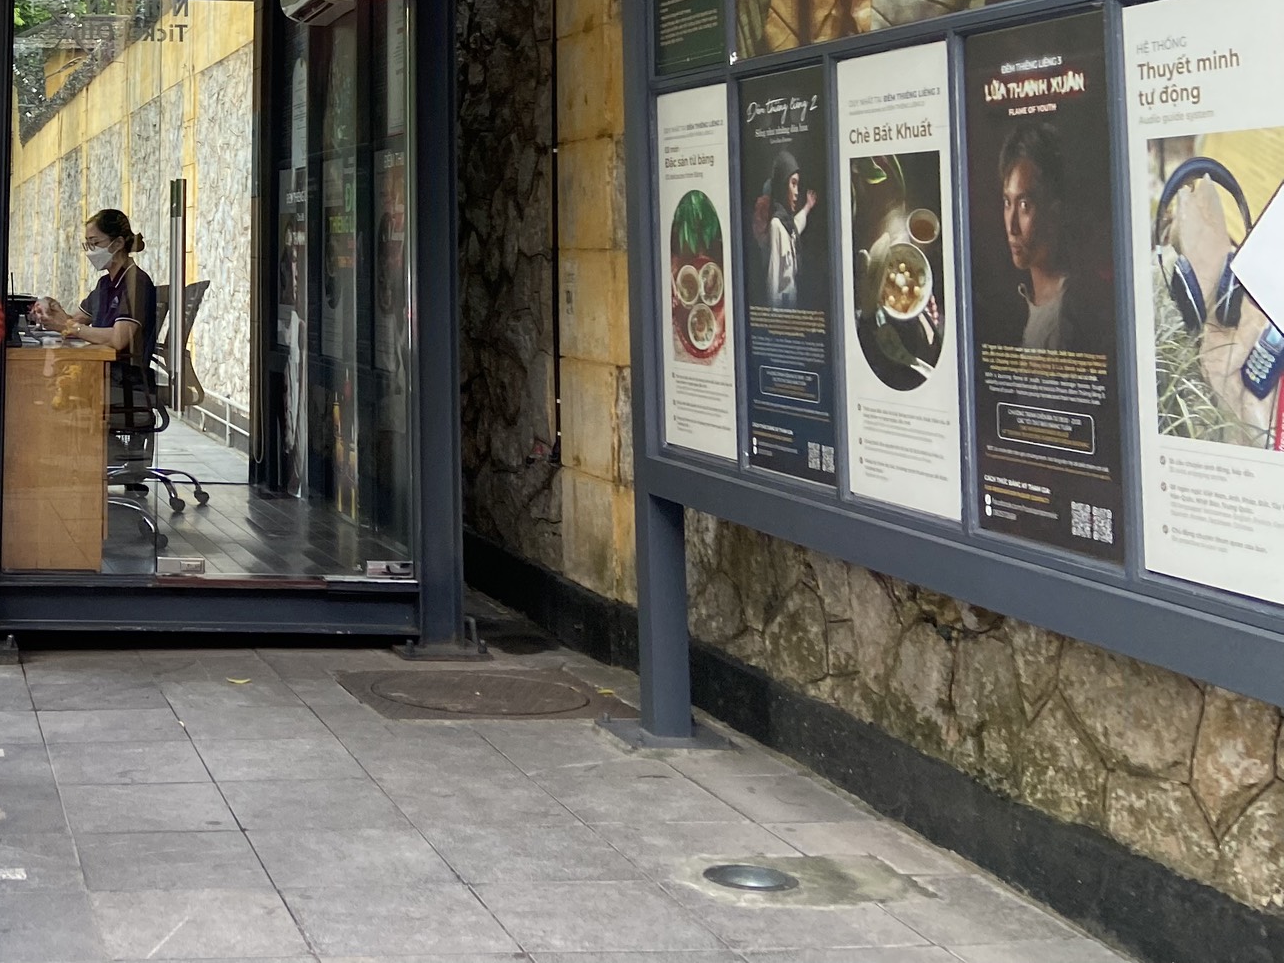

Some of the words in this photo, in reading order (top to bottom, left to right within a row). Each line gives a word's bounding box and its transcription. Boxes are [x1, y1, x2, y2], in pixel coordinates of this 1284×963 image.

[1137, 53, 1192, 81] Thuyết
[1196, 48, 1240, 72] minh
[809, 94, 818, 111] 2
[1138, 87, 1156, 110] tự
[1159, 83, 1200, 108] động
[849, 126, 870, 144] Chè
[873, 122, 893, 142] Bất
[896, 117, 932, 139] Khuất
